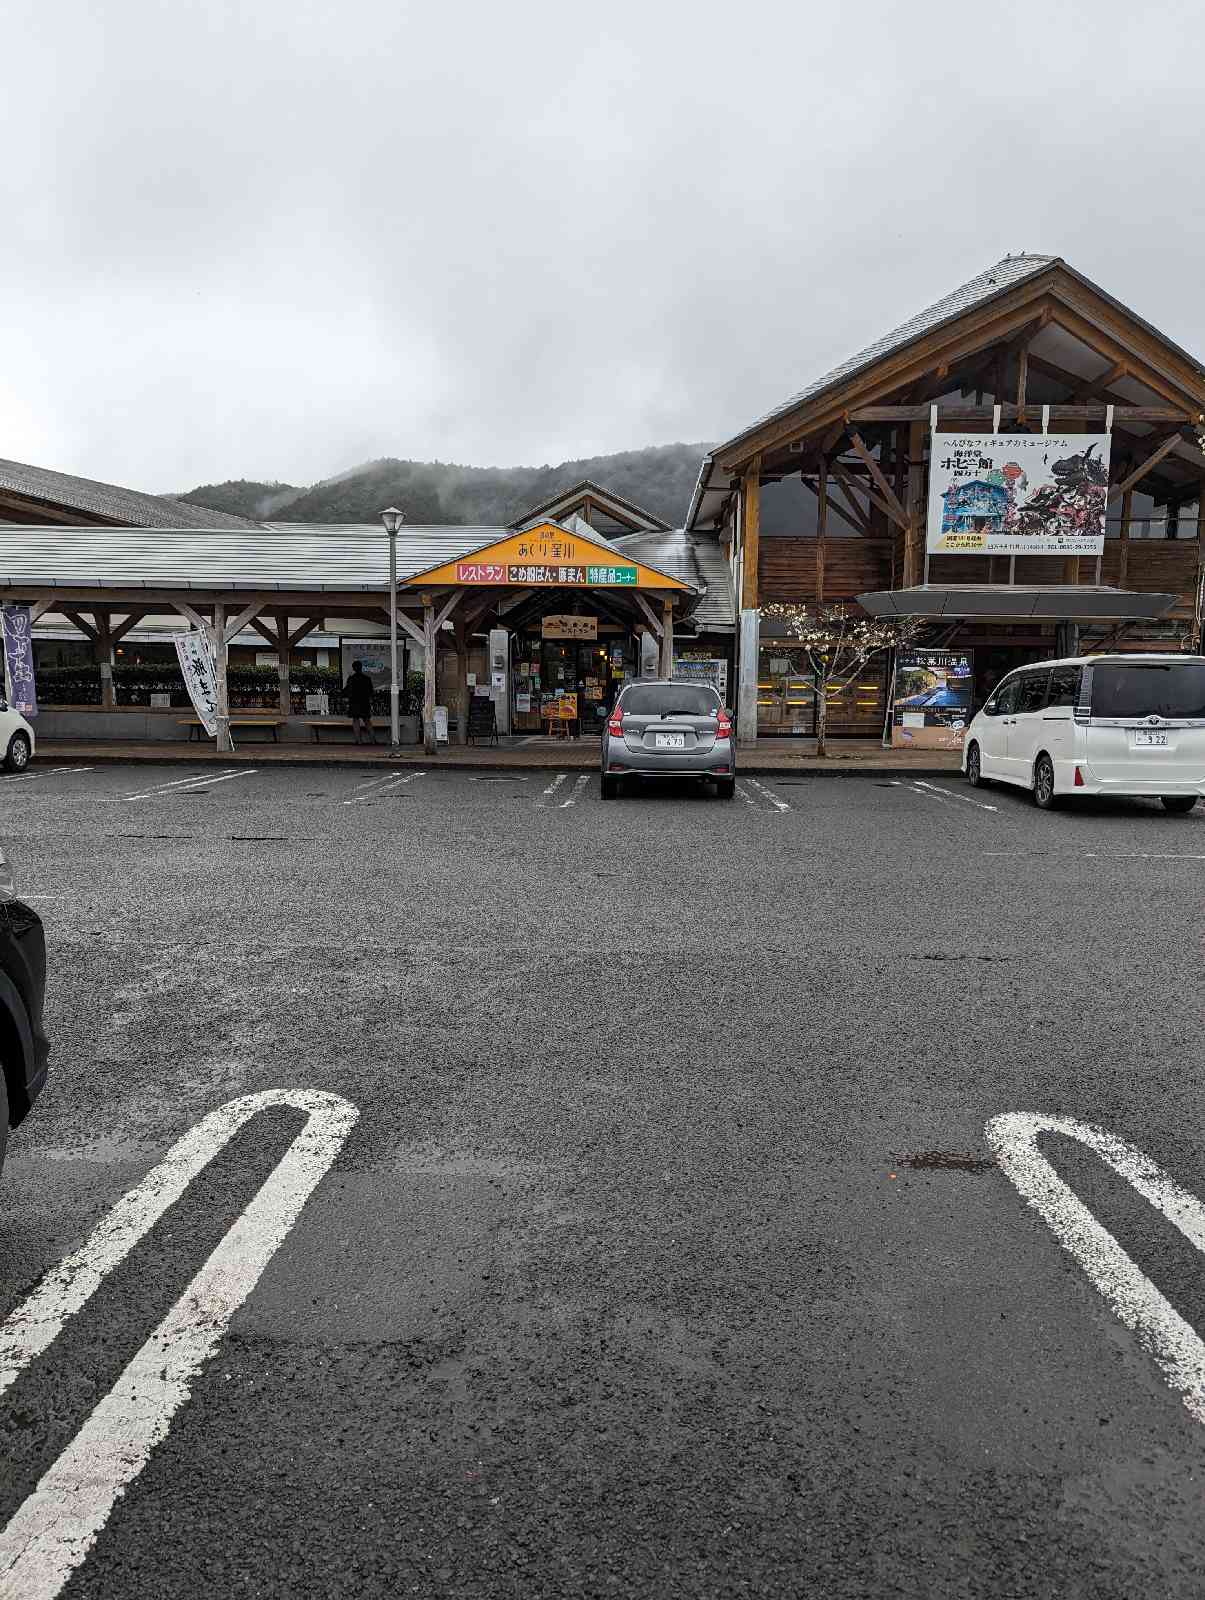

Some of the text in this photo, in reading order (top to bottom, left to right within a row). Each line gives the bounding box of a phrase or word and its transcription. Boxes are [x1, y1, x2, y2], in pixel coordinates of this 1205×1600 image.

[953, 449, 983, 458] 海洋堂
[940, 457, 994, 470] ホビー館
[458, 565, 504, 582] レストラン
[589, 567, 636, 585] 特産品コーナー
